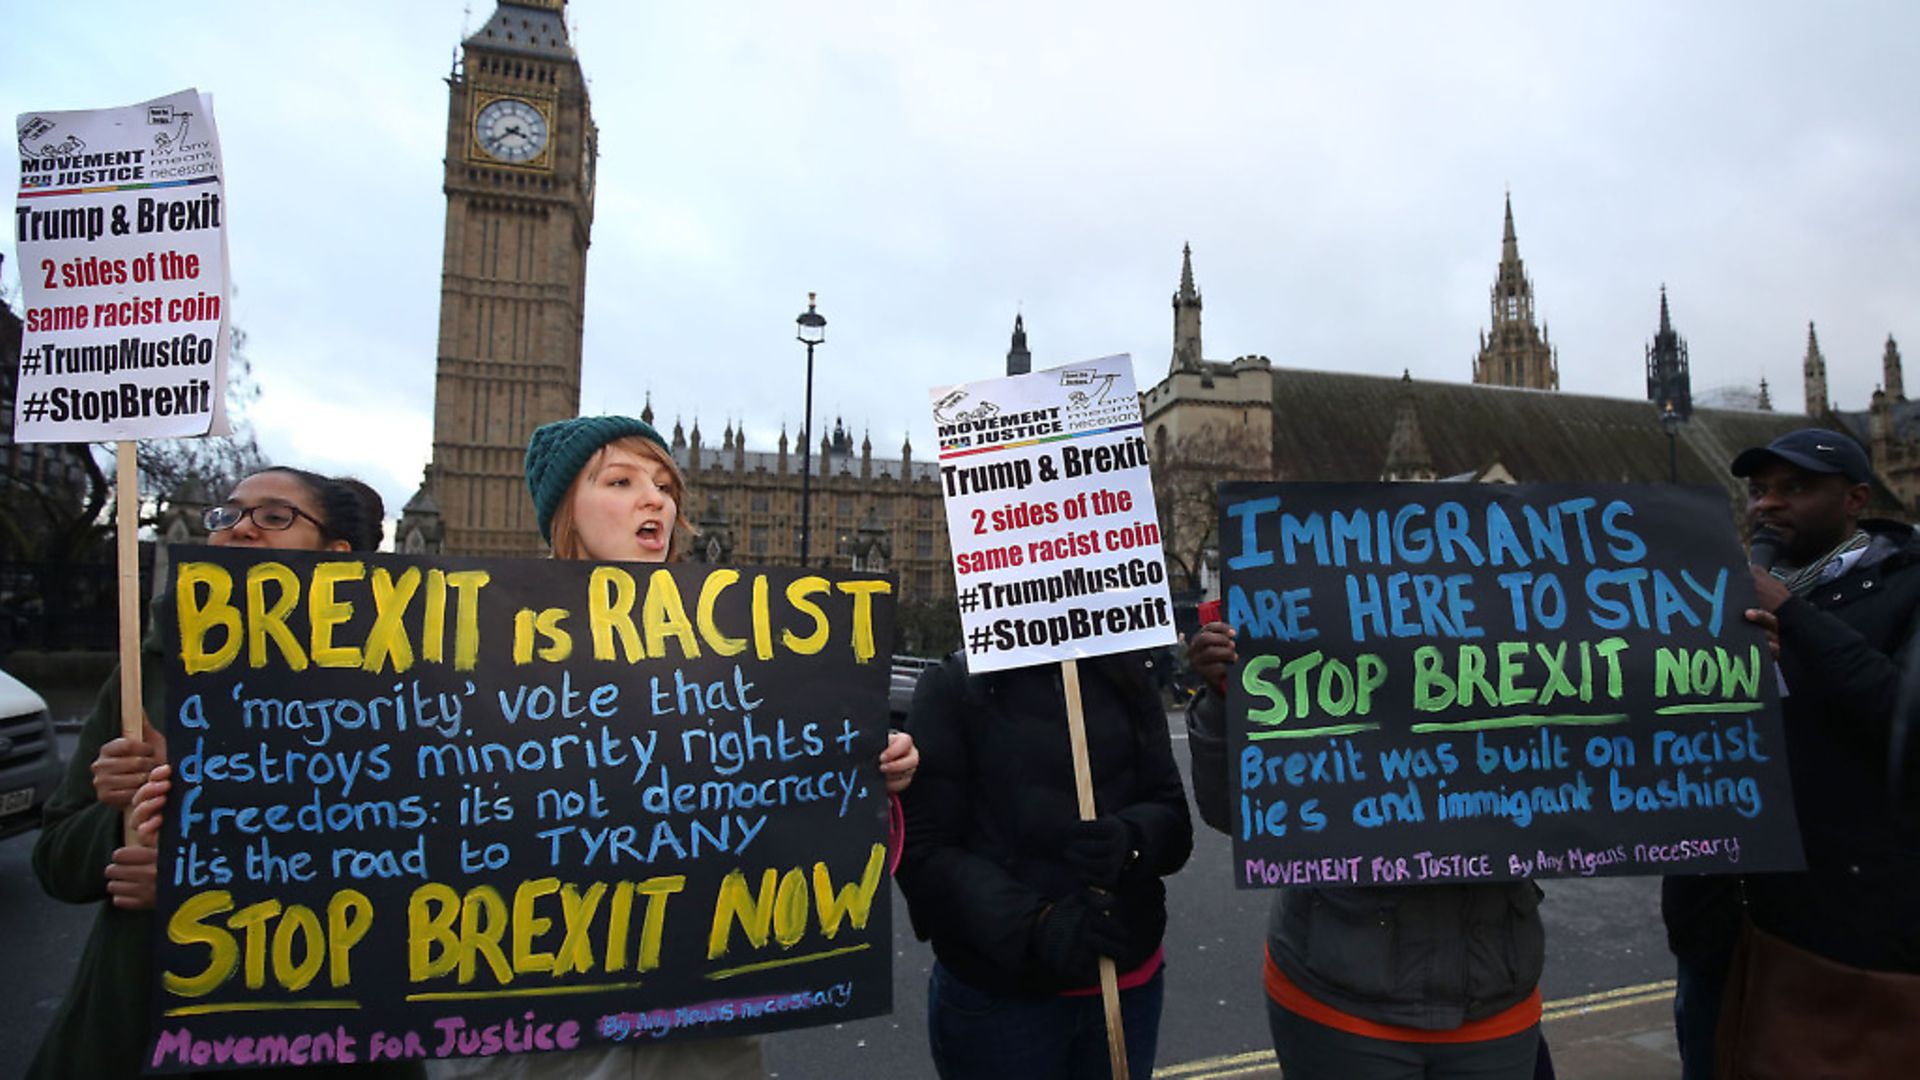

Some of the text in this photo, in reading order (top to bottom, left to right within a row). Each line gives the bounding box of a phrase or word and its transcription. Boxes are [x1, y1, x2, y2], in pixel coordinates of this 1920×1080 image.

[21, 150, 145, 173] MOVEMENT
[22, 166, 144, 186] FOR JUSTICE
[16, 193, 220, 242] Trump & Brexit
[41, 251, 199, 289] 2 sides of the
[27, 291, 220, 332] same racist coin
[22, 333, 213, 376] #TrumpMustGo
[23, 379, 210, 423] #StopBrexit
[938, 406, 1061, 438] MOVEMENT
[1069, 412, 1141, 430] necessary
[939, 421, 1063, 447] FOR JUSTICE
[941, 436, 1149, 497] Trump & Brexit
[971, 489, 1132, 535] 2 sides of the
[1227, 496, 1647, 570] IMMIGRANTS
[957, 522, 1160, 575] same racist coin
[959, 558, 1164, 613] #TrumpMustGo
[1227, 567, 1728, 642] ARE HERE TO STAY
[177, 561, 491, 675] BREXIT
[588, 566, 891, 664] RACIST
[968, 597, 1170, 654] #StopBrexit
[179, 694, 210, 730] a
[498, 671, 620, 723] vote
[651, 664, 763, 716] that
[1242, 637, 1760, 726] STOP BREXIT NOW
[179, 713, 861, 798] destroys minority rights +
[1241, 718, 1771, 789] Brexit was built on racist
[180, 786, 441, 838] freedoms:
[537, 778, 609, 820] not
[641, 764, 869, 818] democracy.
[1240, 766, 1762, 842] lies and immigrant bashing
[246, 836, 318, 883] the
[332, 834, 428, 879] road
[460, 839, 511, 874] to
[536, 815, 768, 866] TYRANY
[1246, 855, 1363, 884] MOVEMENT
[1371, 855, 1411, 883] FOR
[1413, 850, 1493, 880] JUSTICE
[1508, 854, 1533, 878] By
[1634, 837, 1740, 863] necessary
[163, 842, 886, 998] STOP BREXIT NOW
[151, 1025, 357, 1067] Movement
[434, 1011, 580, 1057] Justice
[603, 1013, 631, 1041] By
[636, 1012, 671, 1038] Any
[675, 1003, 735, 1028] Means
[740, 981, 852, 1018] necessary
